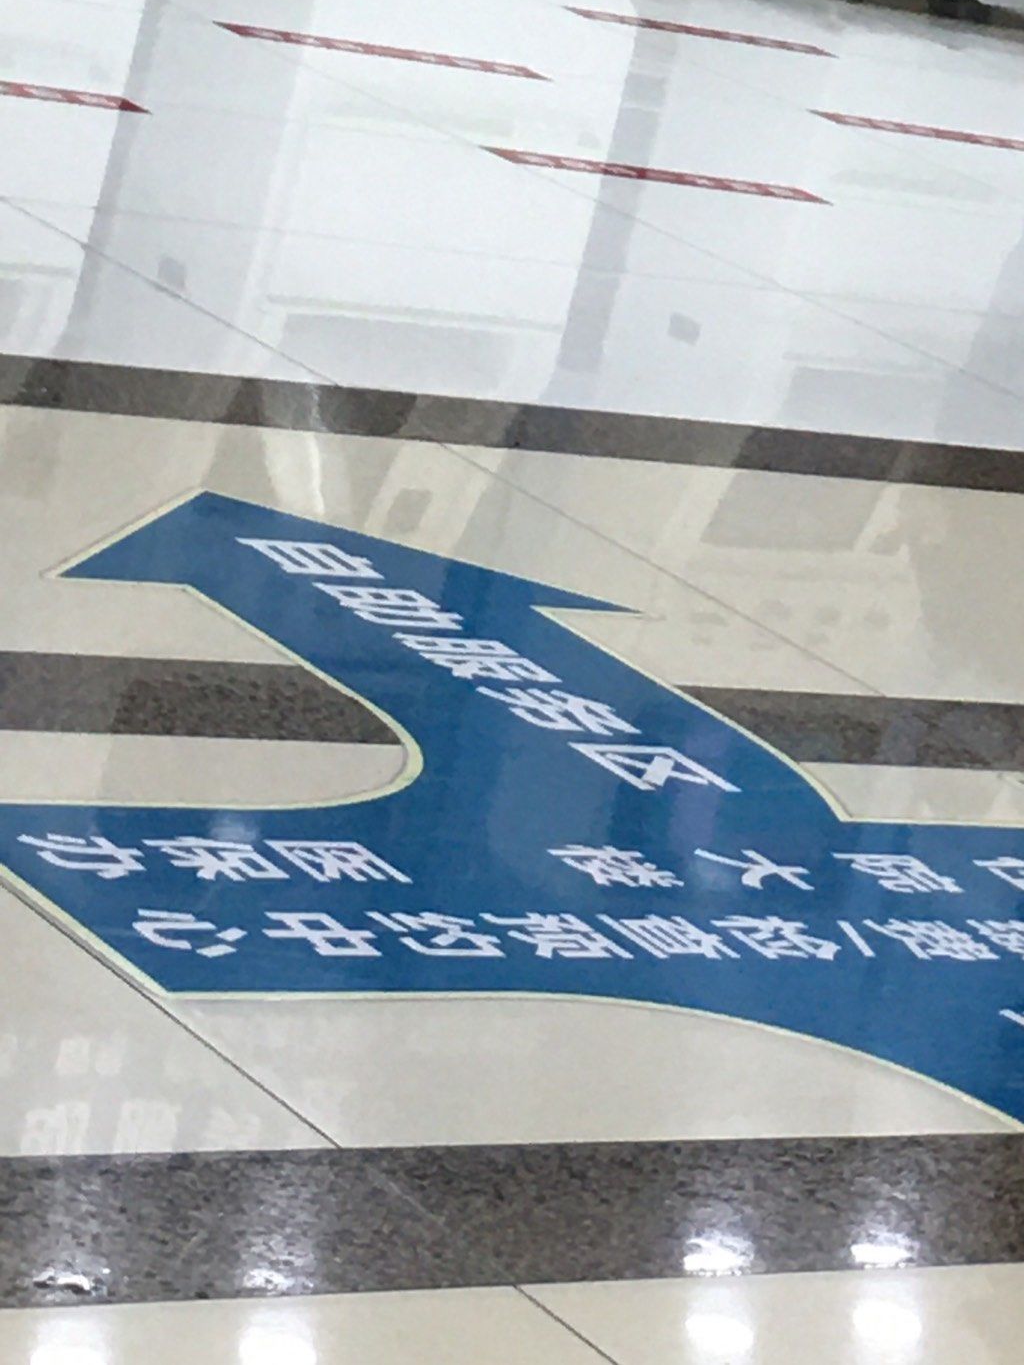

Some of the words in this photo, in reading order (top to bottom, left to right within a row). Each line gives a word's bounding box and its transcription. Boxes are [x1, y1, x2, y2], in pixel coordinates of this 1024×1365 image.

[237, 538, 740, 792] 自助服务区
